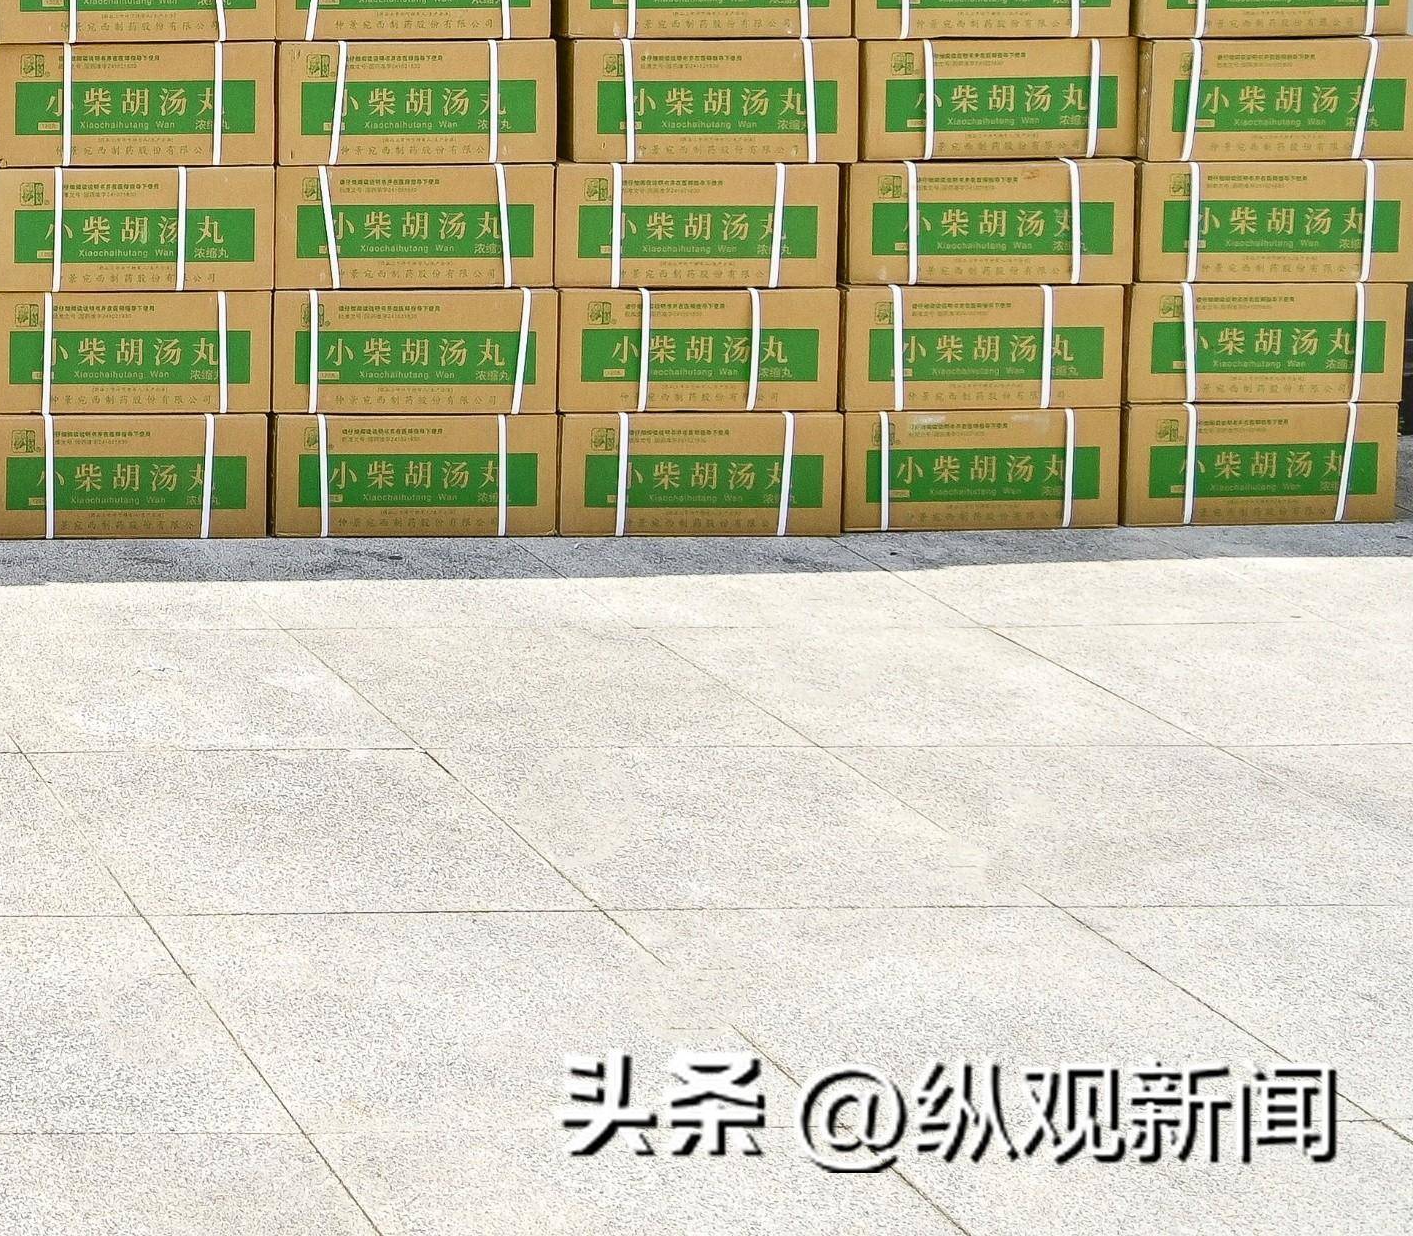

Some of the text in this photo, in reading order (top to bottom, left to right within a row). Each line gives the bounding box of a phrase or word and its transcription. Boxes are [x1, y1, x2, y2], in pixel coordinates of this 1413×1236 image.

[46, 87, 225, 117] 小柴胡汤丸
[637, 87, 804, 116] 小柴胡汤丸
[1202, 85, 1376, 114] 小柴胡汤丸
[662, 121, 757, 130] Xiaochaihutang Wan
[337, 211, 499, 240] 小柴胡汤丸
[609, 212, 786, 241] 小柴胡汤丸
[1201, 206, 1363, 235] 小柴胡汤丸
[79, 249, 148, 258] Xiaochaihutang
[155, 249, 173, 257] Wan
[41, 337, 217, 366] 小柴胡汤丸
[326, 338, 506, 367] 小柴胡汤丸
[612, 335, 788, 364] 小柴胡汤丸
[905, 334, 1074, 363] 小柴胡汤丸
[360, 371, 429, 380] Xiaochaihutang
[436, 371, 454, 379] Wan
[330, 460, 496, 489] 小柴胡汤丸
[616, 461, 793, 490] 小柴胡汤丸
[897, 454, 1063, 483] 小柴胡汤丸
